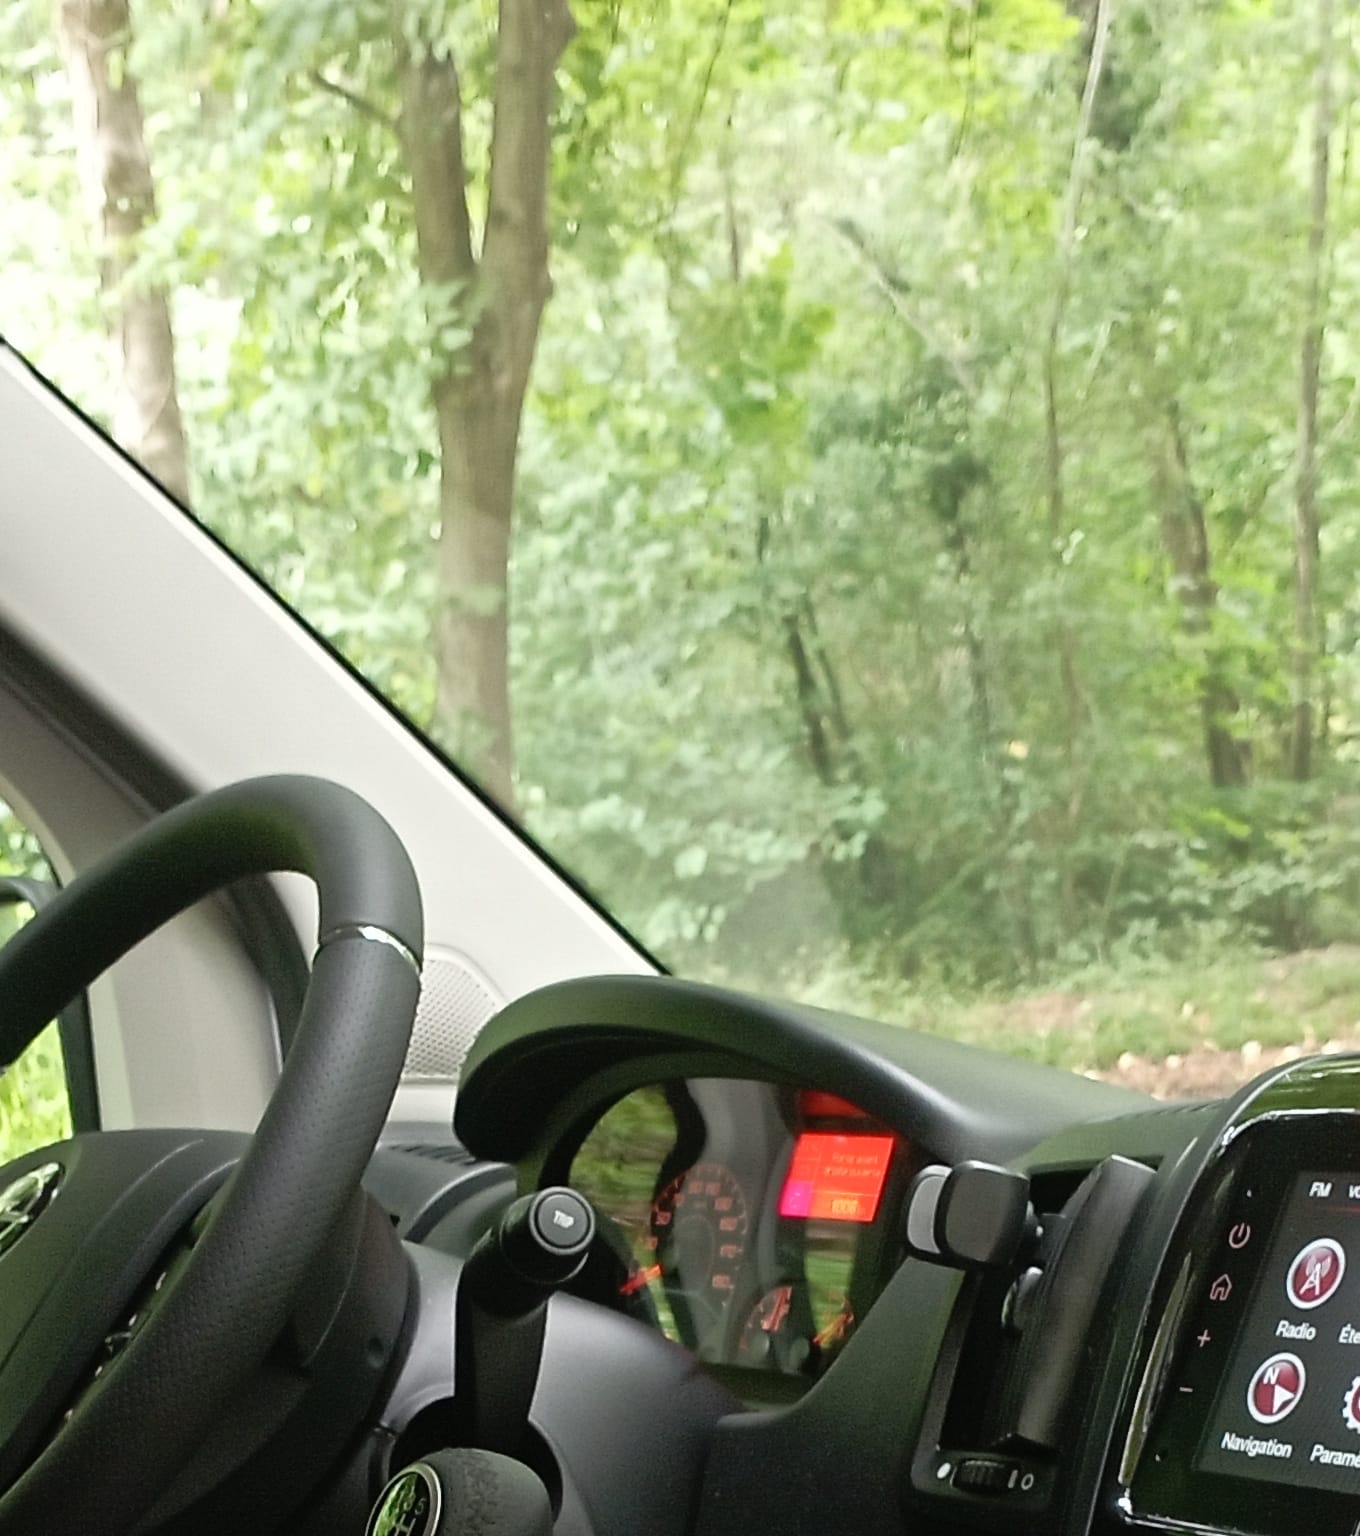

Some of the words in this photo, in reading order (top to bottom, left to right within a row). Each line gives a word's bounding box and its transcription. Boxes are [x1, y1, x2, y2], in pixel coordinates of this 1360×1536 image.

[1309, 1181, 1332, 1198] FM
[1275, 1320, 1316, 1340] Radio
[1221, 1432, 1293, 1458] Navigation
